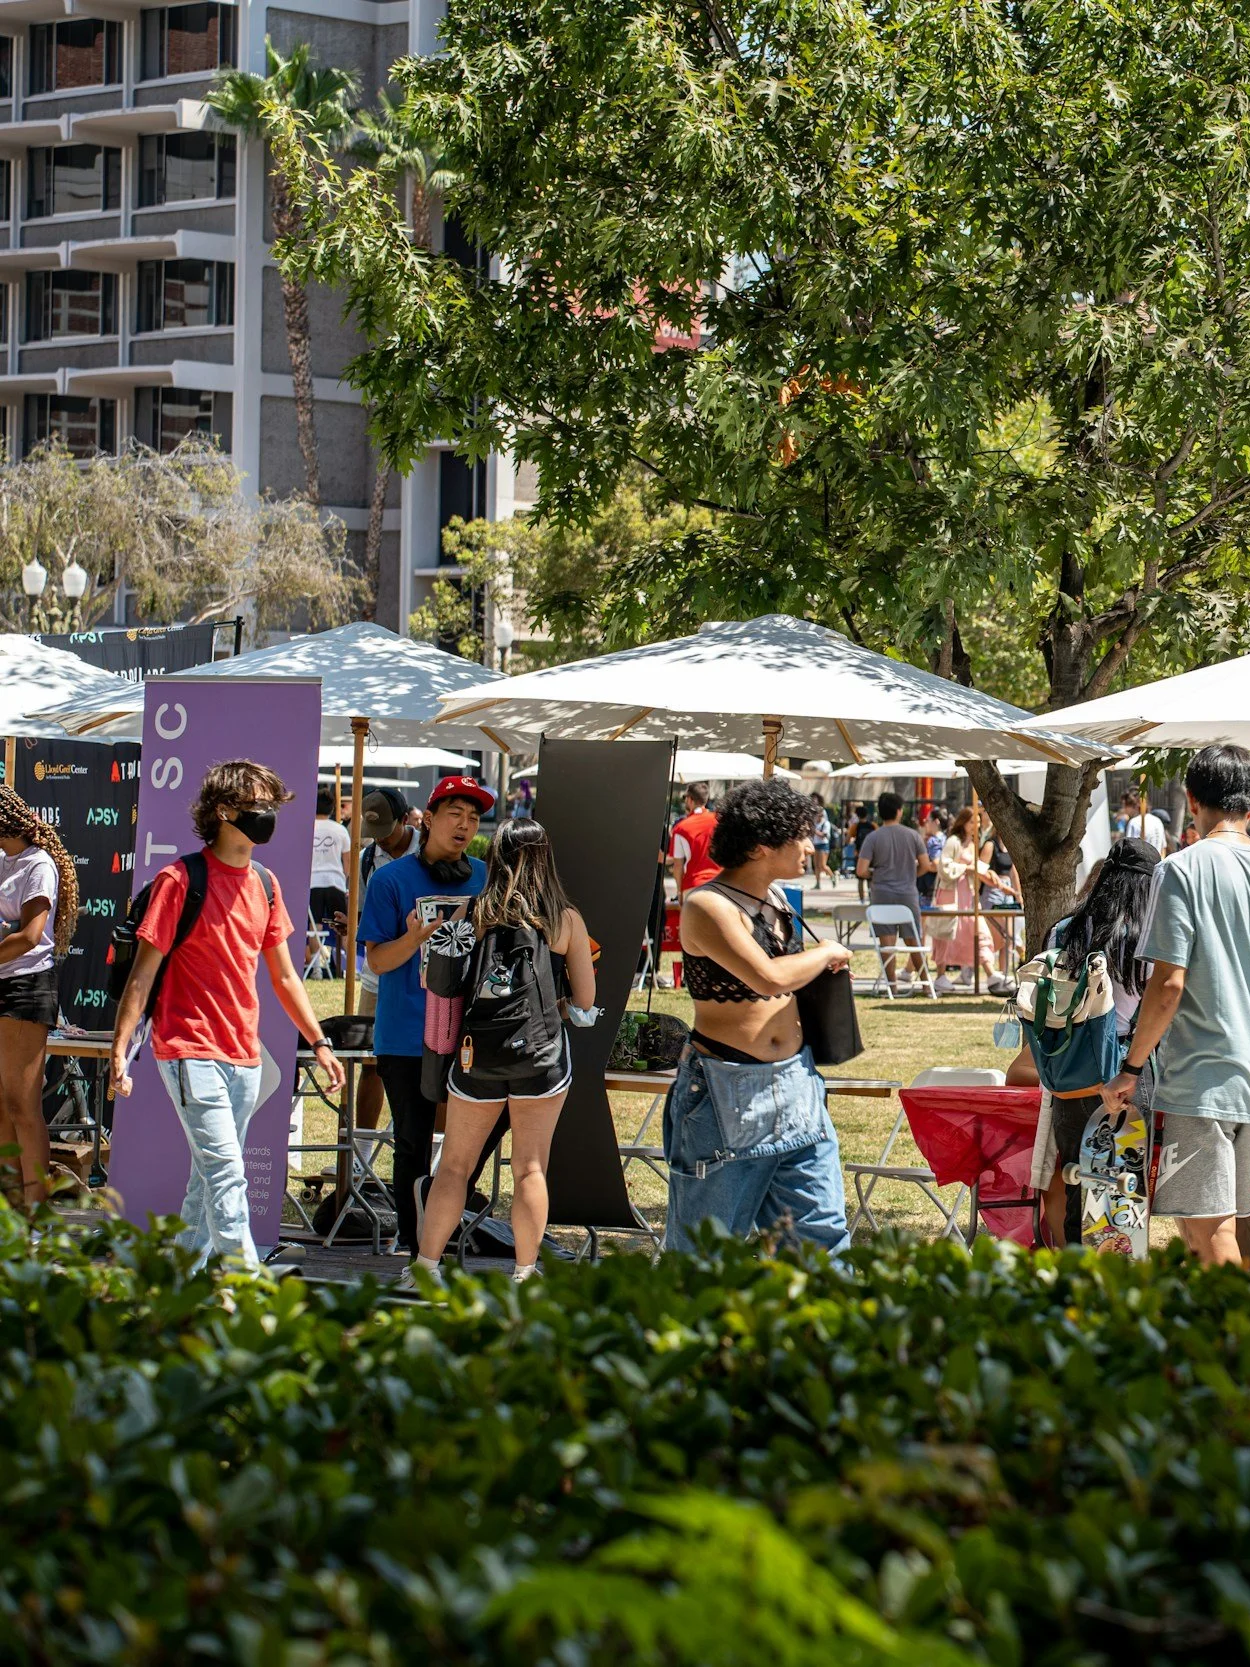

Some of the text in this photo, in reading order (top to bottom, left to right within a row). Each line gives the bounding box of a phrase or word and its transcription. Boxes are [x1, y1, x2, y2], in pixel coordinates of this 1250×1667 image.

[71, 764, 88, 775] Center
[86, 807, 119, 825] APSY
[74, 988, 107, 1008] APSY
[253, 1176, 271, 1185] and
[1082, 1188, 1148, 1229] Max
